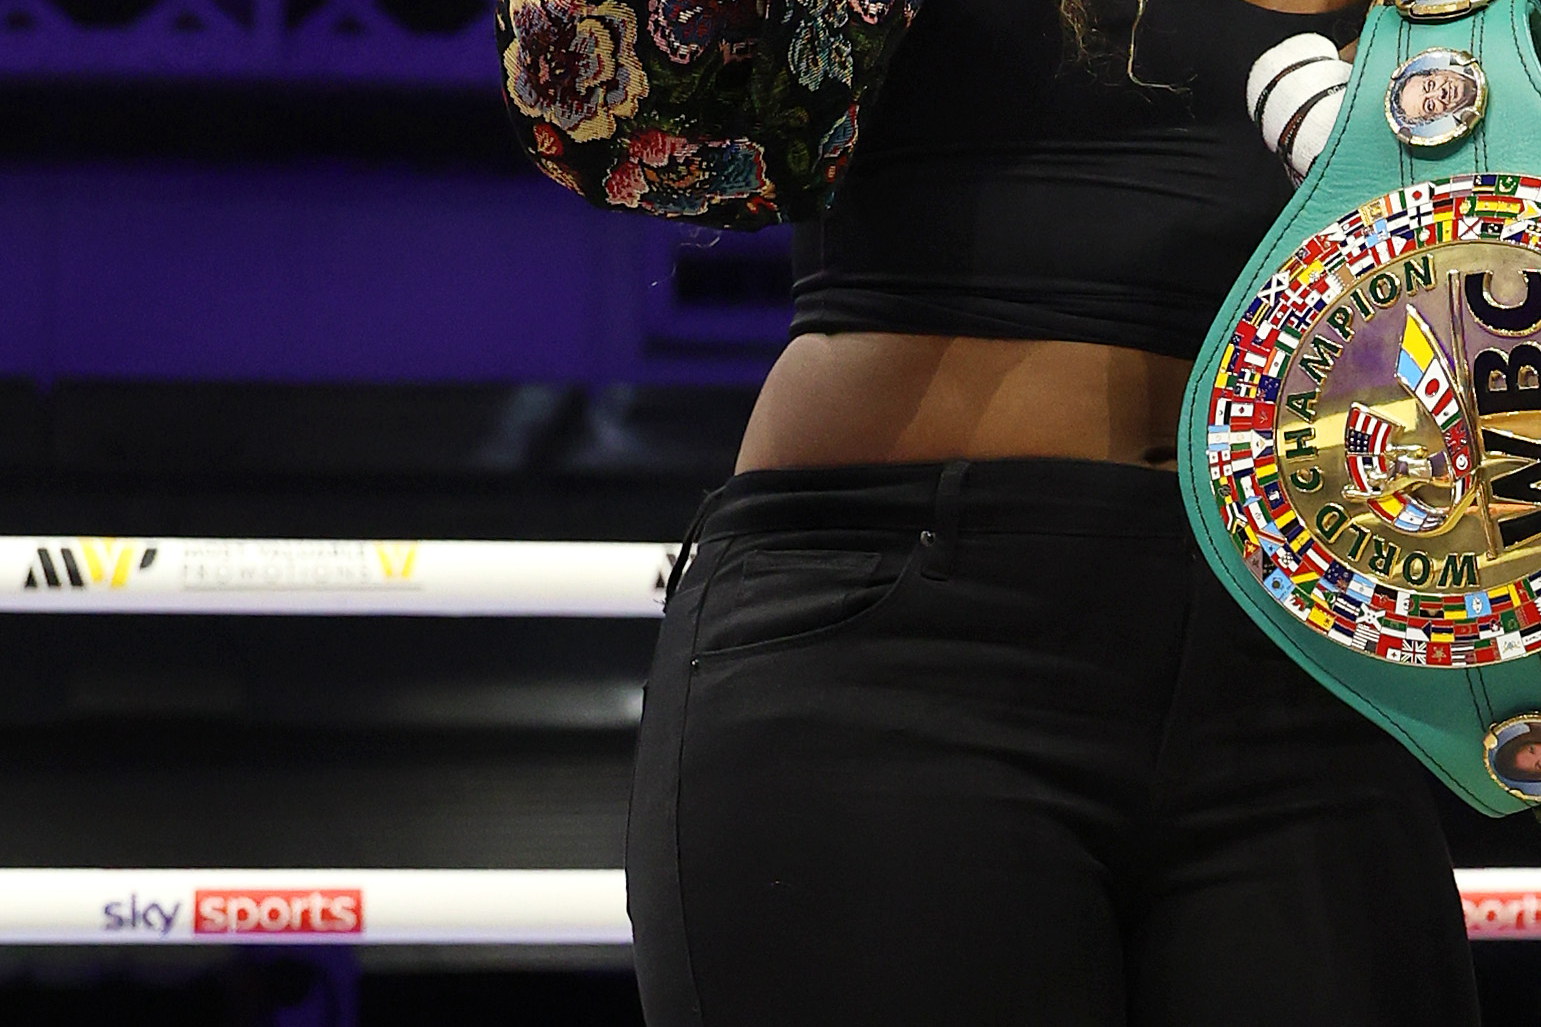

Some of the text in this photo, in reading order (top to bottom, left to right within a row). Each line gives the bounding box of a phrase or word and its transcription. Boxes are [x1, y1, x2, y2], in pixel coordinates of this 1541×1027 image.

[1283, 253, 1480, 588] WORLD CHAMPION
[104, 891, 358, 939] sky sports
